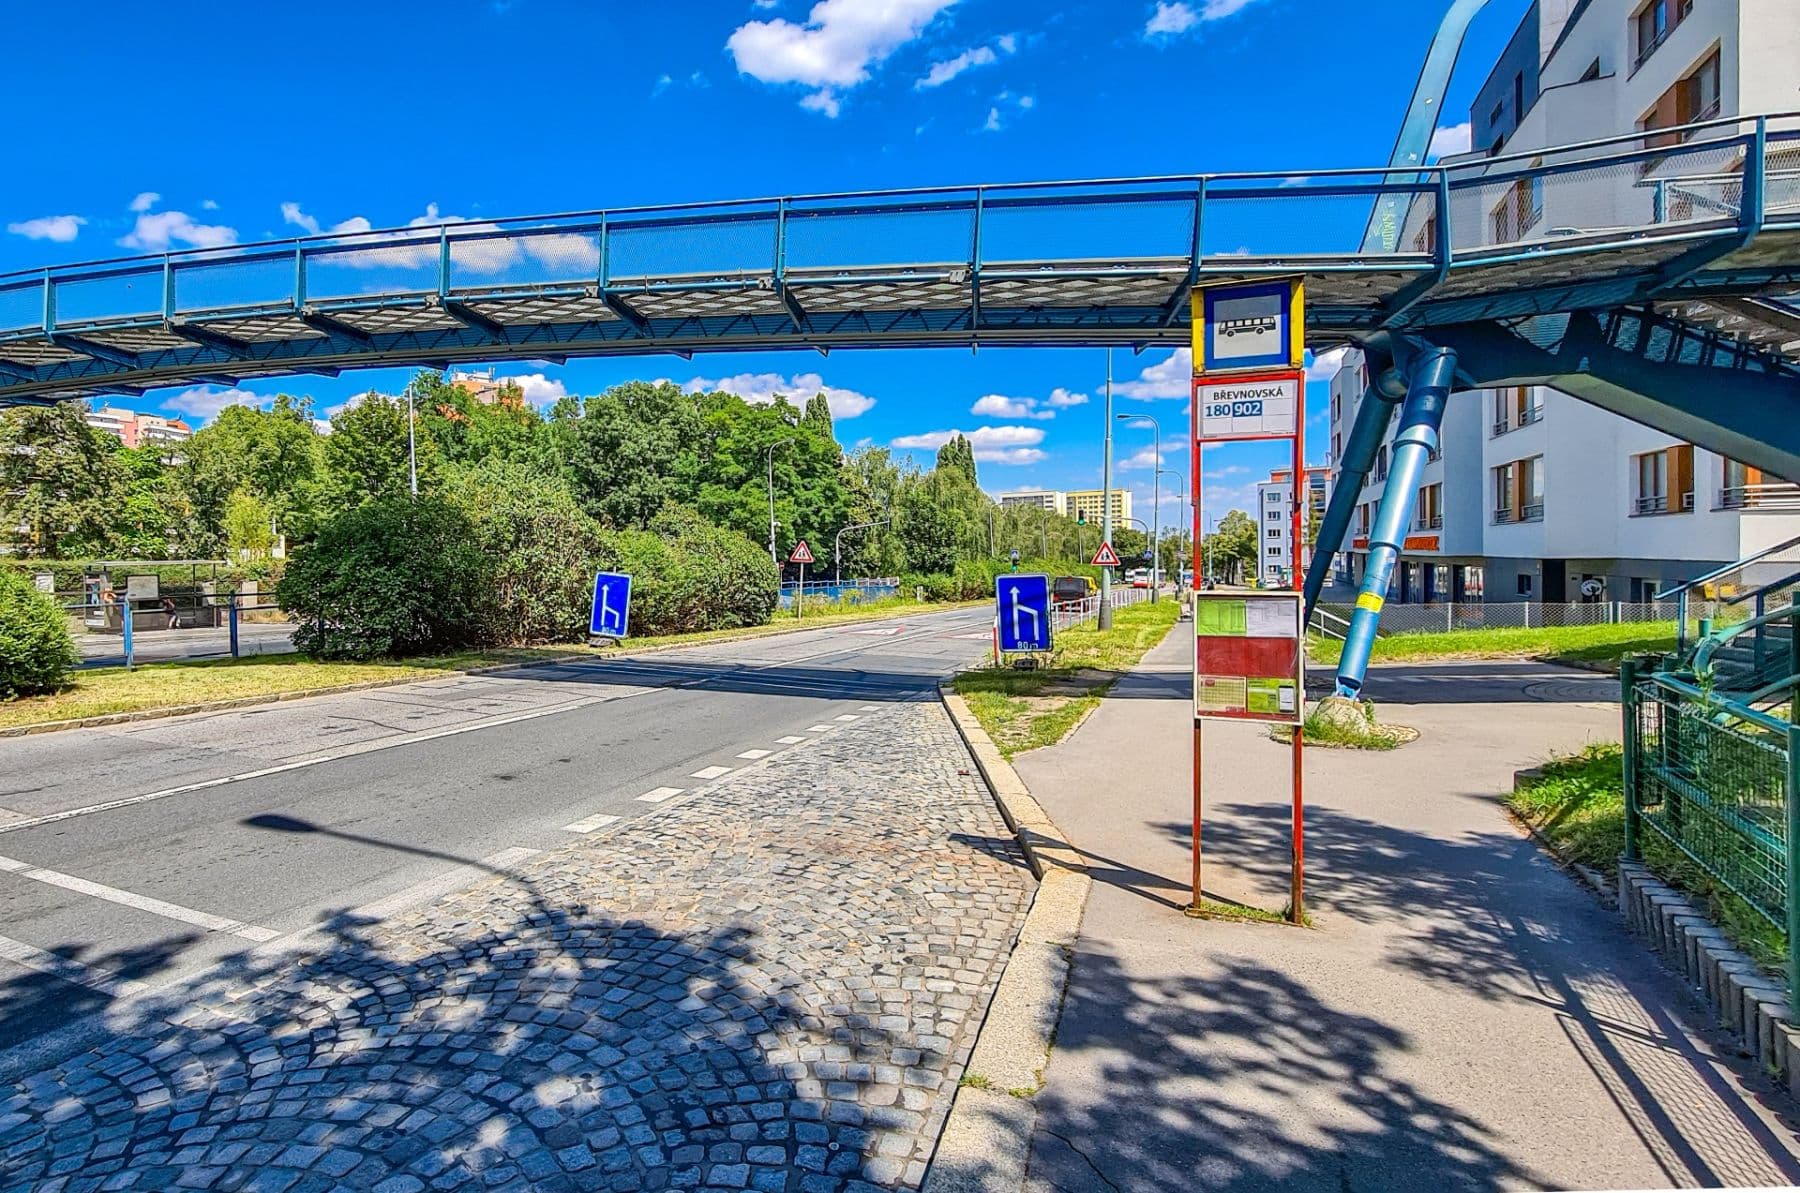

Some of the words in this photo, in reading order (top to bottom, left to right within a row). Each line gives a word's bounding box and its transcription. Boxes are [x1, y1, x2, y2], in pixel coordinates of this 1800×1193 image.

[1213, 386, 1283, 400] BŘEVNOVSKÁ
[1205, 404, 1231, 417] 180
[1233, 402, 1261, 416] 902
